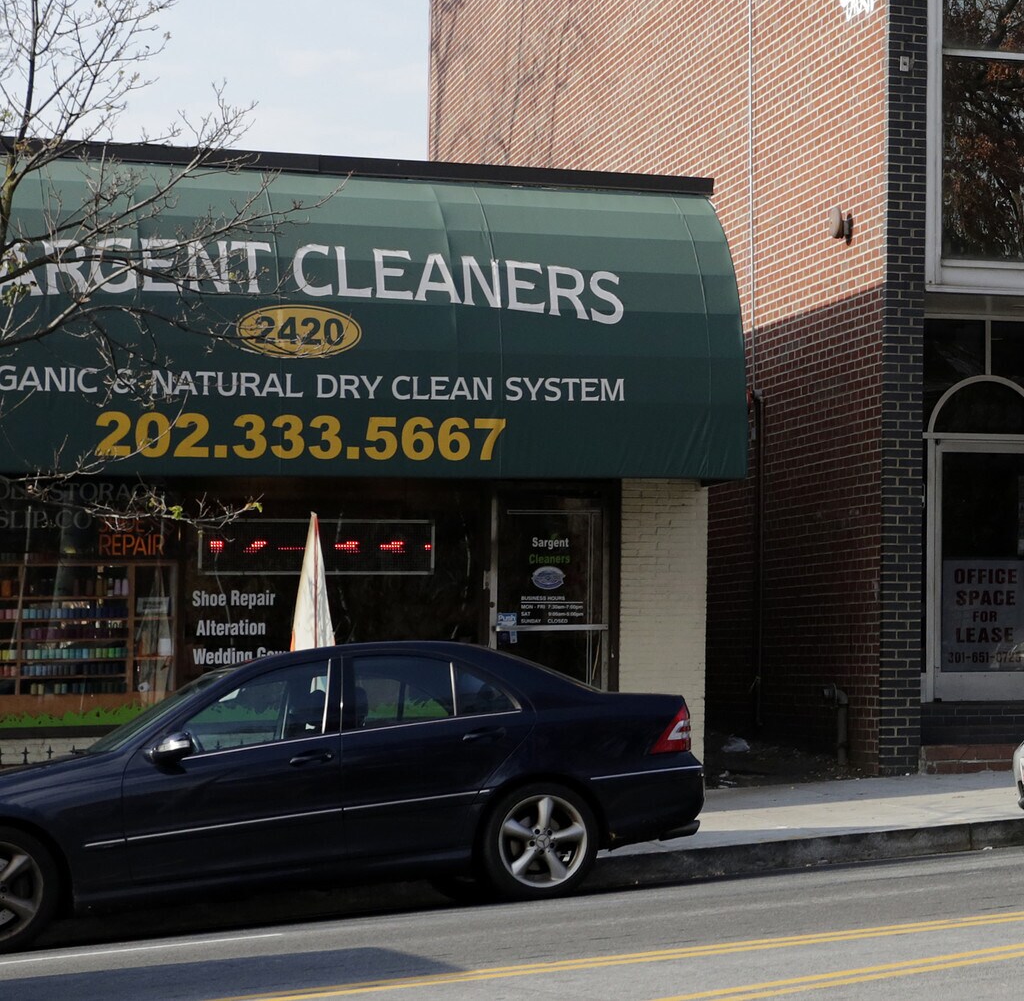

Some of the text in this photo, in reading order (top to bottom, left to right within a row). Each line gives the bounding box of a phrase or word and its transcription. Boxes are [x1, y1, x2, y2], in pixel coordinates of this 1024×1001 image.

[293, 243, 625, 324] CLEANERS
[251, 316, 345, 346] 2420
[152, 370, 304, 399] NATURAL
[317, 374, 383, 399] DRY
[391, 375, 493, 400] CLEAN
[505, 377, 625, 401] SYSTEM
[95, 410, 507, 461] 202.333.5667
[98, 534, 165, 556] REPAIR
[532, 537, 569, 550] Sargent
[529, 554, 571, 564] Cleaners
[954, 568, 1018, 584] OFFICE
[192, 590, 276, 609] Shoe Repair
[955, 590, 1016, 606] SPACE
[972, 610, 998, 622] FOR
[196, 619, 266, 636] Alteration
[956, 627, 1014, 644] LEASE
[193, 647, 253, 665] Wedding
